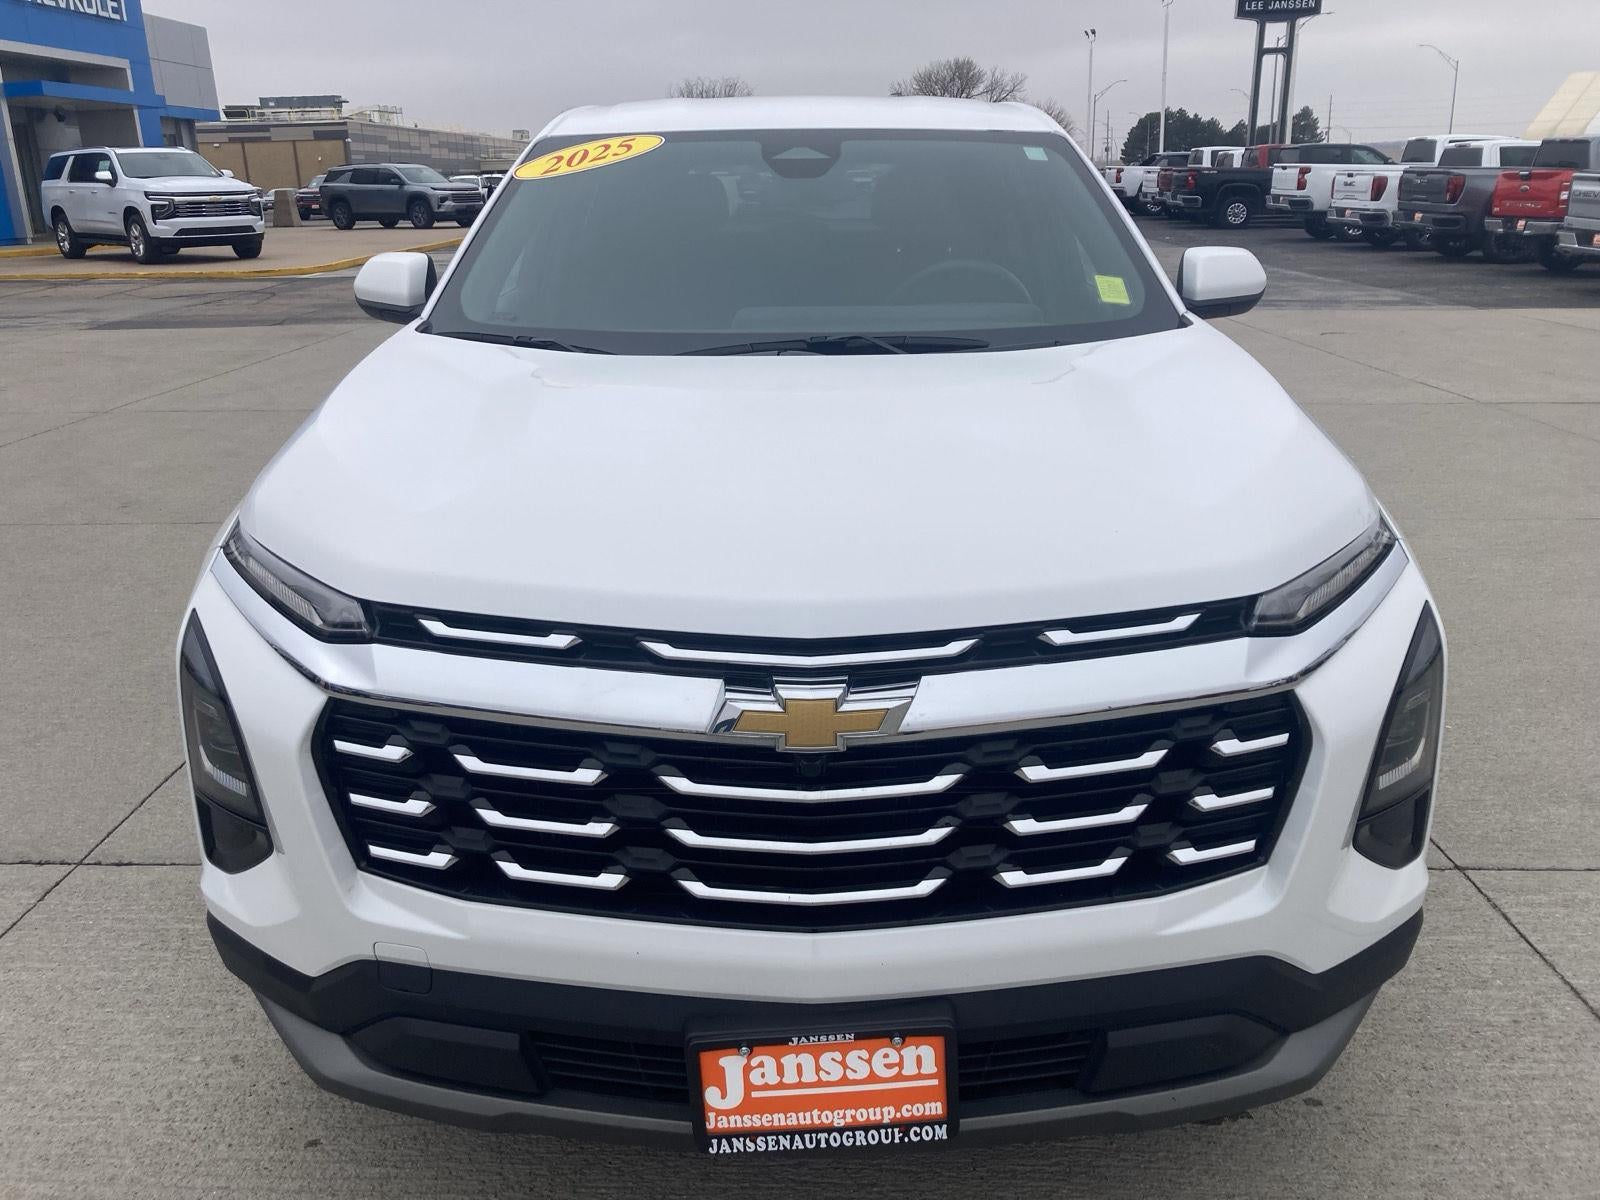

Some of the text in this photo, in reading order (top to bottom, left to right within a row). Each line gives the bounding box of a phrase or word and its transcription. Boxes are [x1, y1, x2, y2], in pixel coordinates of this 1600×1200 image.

[1245, 0, 1316, 11] LEE JANSSEN
[541, 137, 636, 175] 2025
[788, 1034, 855, 1046] JANSSEN
[704, 1045, 938, 1110] Janssen
[706, 1101, 943, 1129] Janssenautogroup.com
